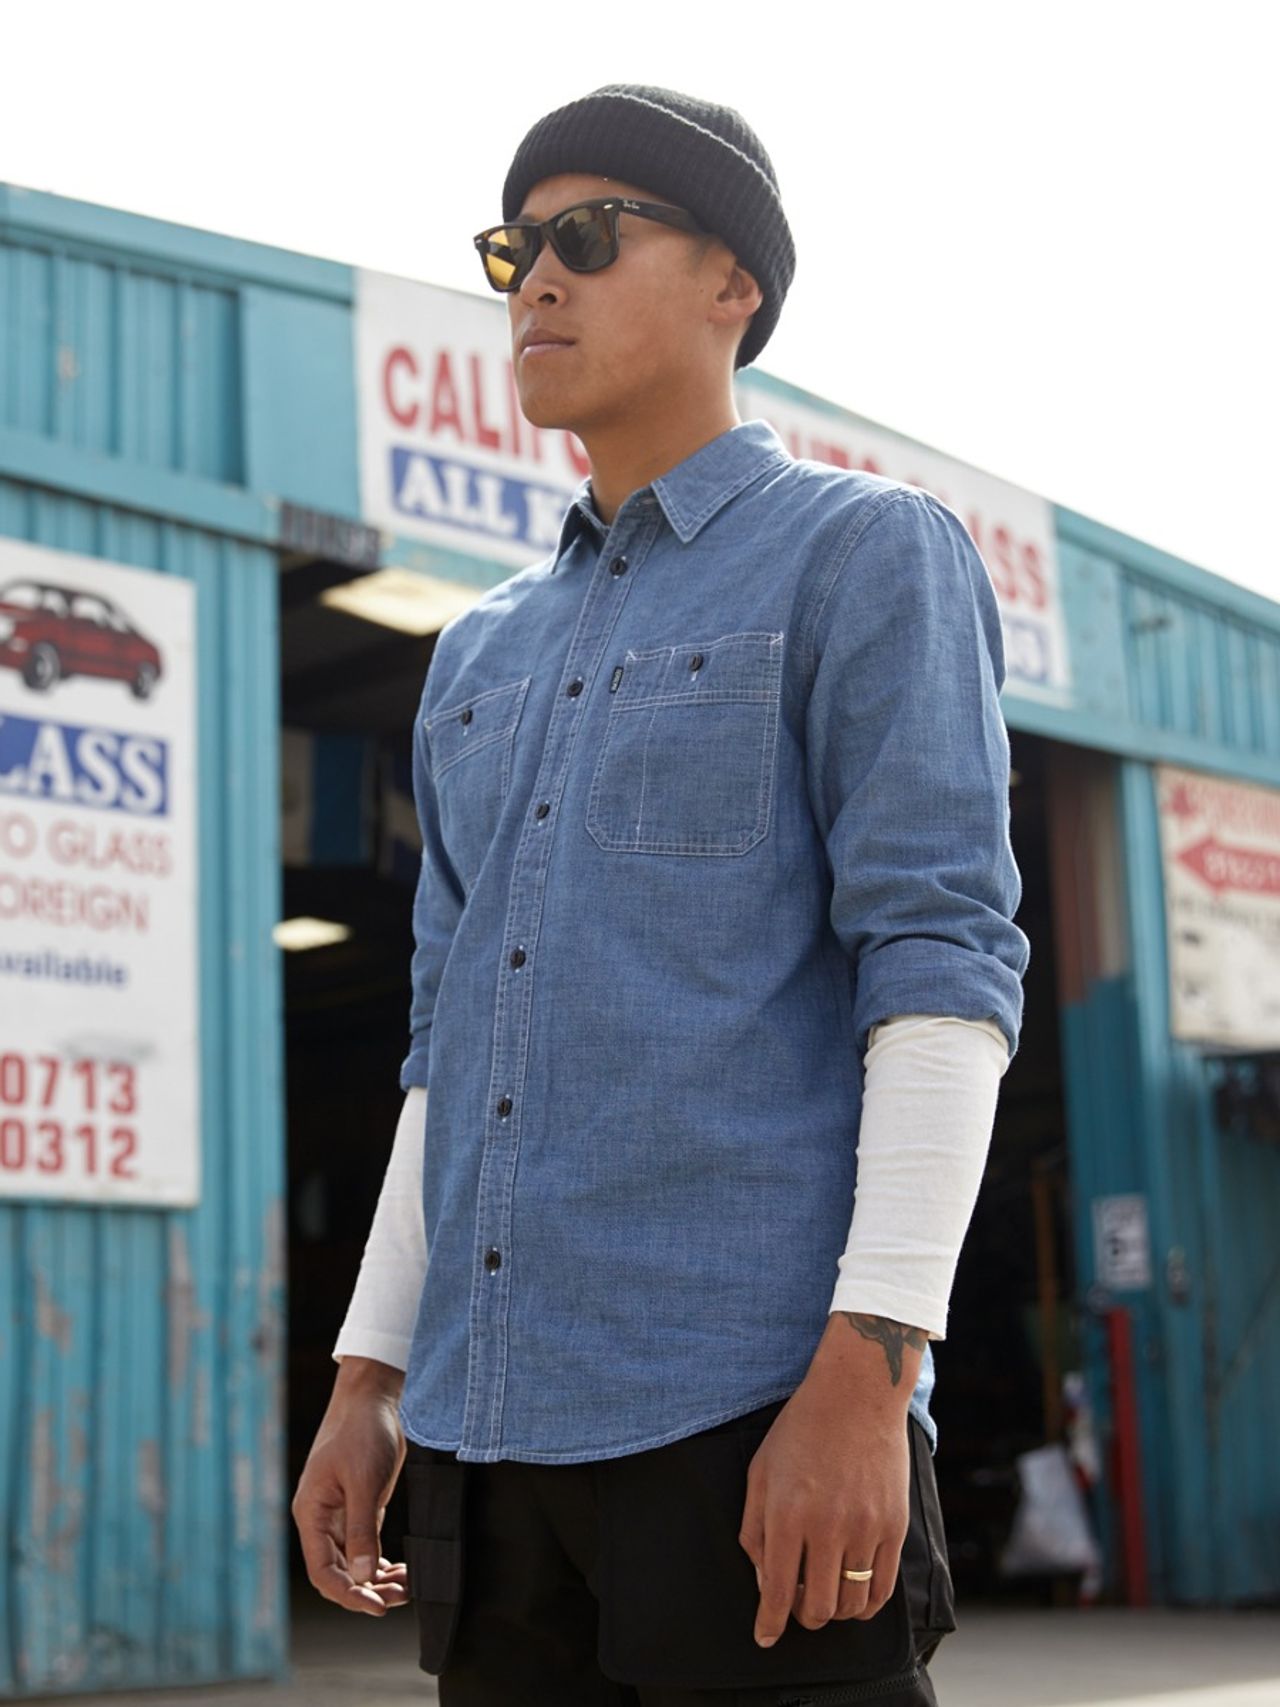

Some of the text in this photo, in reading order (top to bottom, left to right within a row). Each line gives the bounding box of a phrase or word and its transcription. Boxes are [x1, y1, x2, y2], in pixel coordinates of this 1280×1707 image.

[381, 345, 592, 479] CALI
[399, 454, 518, 540] ALL
[47, 819, 172, 878] GLASS
[0, 1053, 136, 1115] 0713
[0, 1118, 138, 1180] 0312
